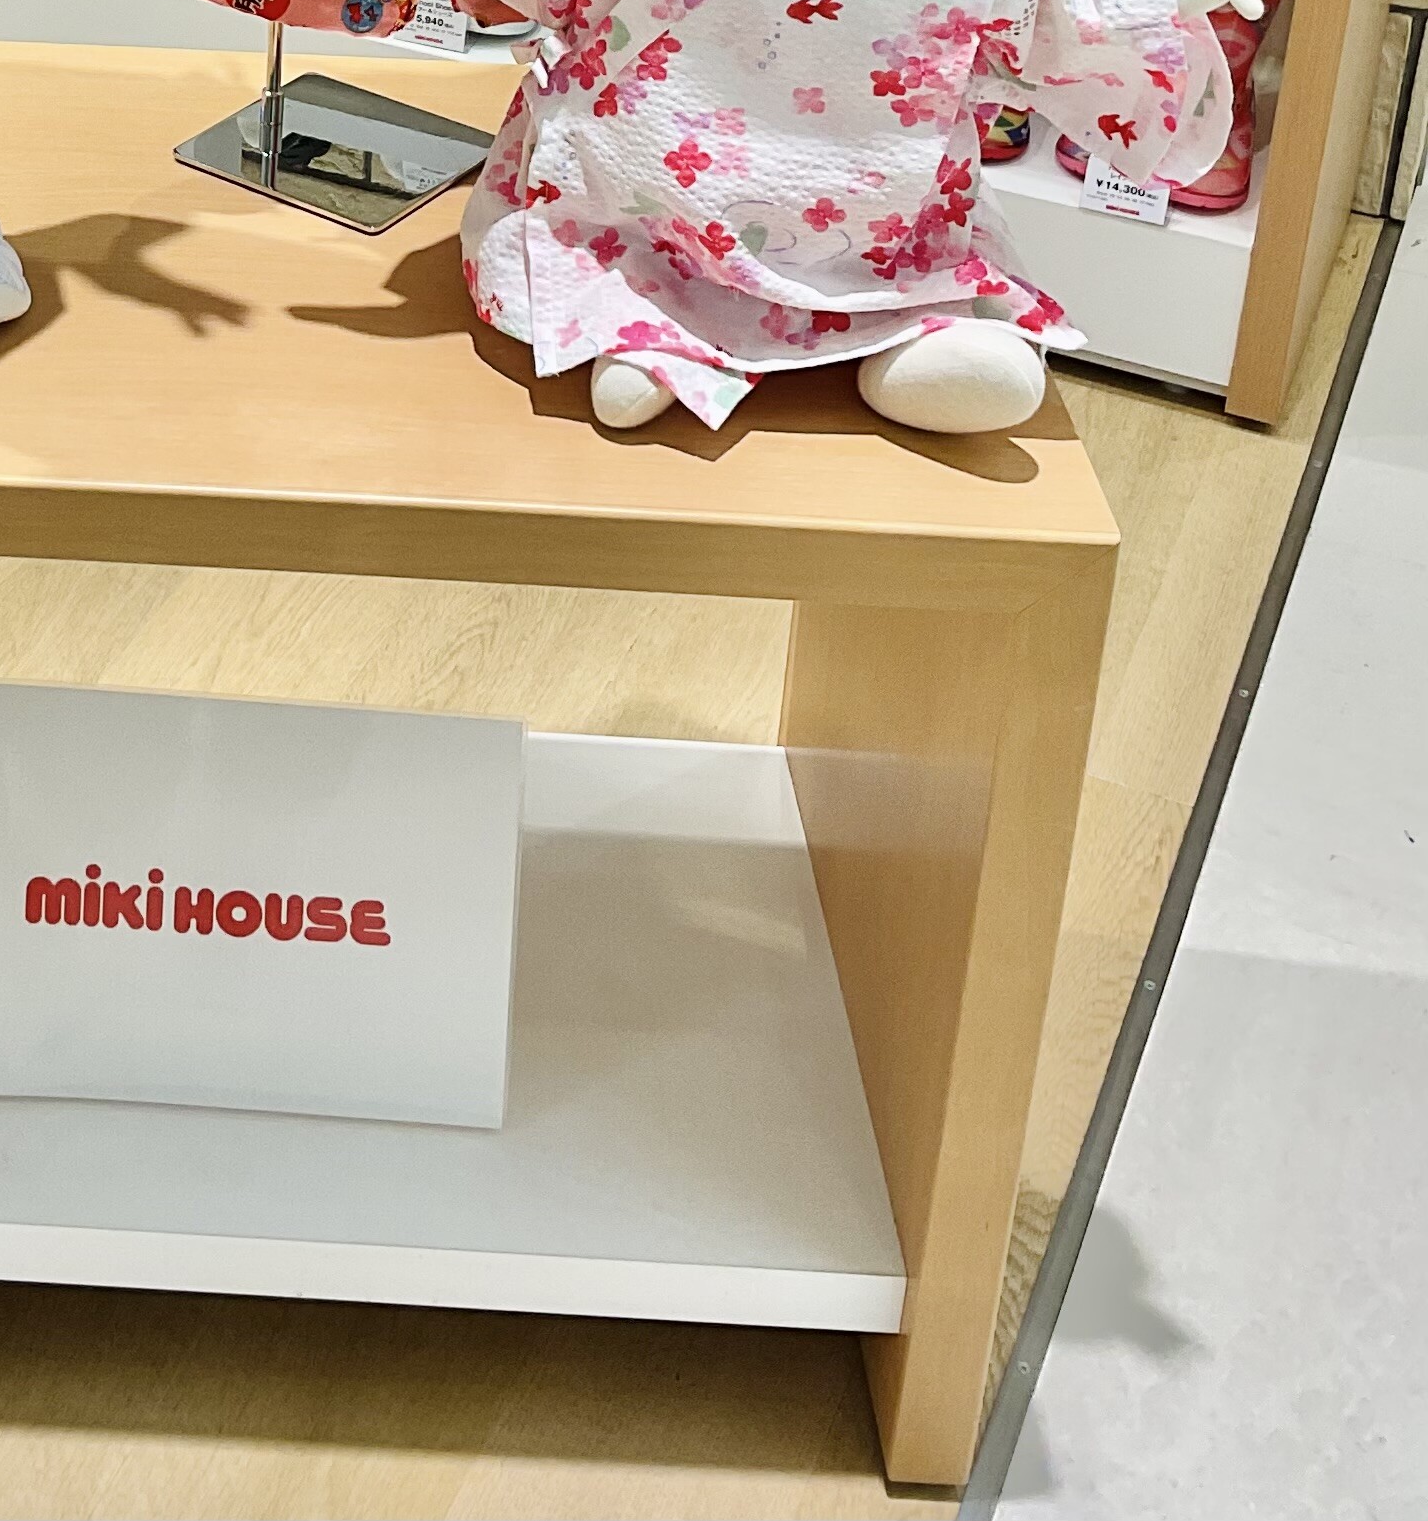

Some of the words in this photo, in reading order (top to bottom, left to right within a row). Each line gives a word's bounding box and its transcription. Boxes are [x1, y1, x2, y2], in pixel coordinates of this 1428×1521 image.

[1096, 178, 1146, 197] ¥14,300
[25, 863, 165, 932] miki
[173, 886, 392, 947] HOUSE
